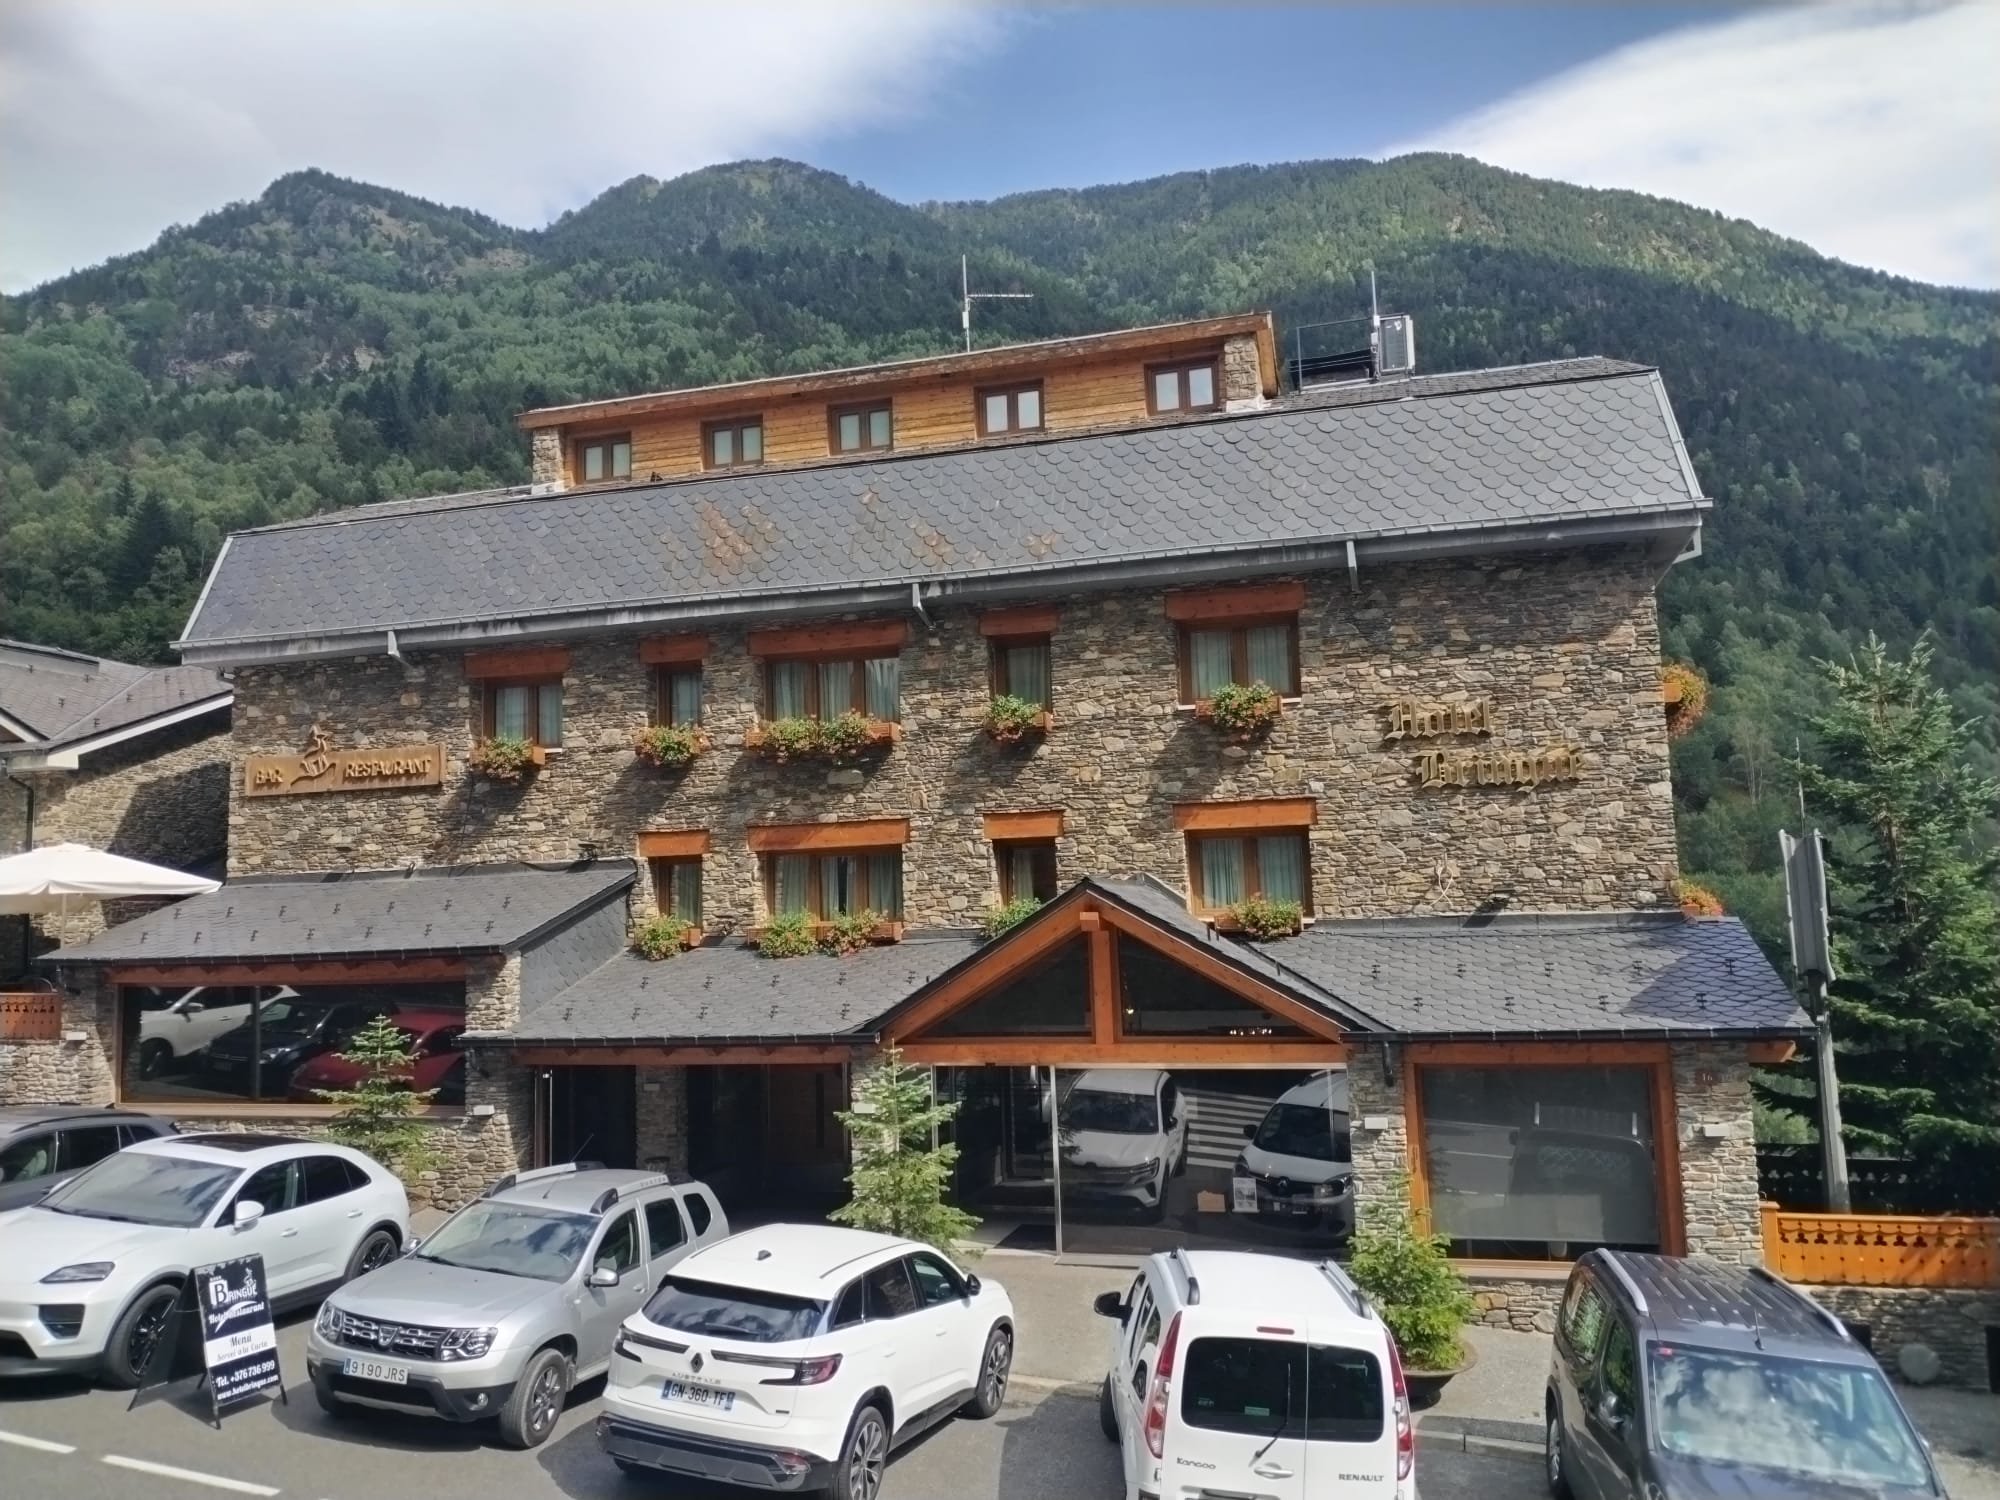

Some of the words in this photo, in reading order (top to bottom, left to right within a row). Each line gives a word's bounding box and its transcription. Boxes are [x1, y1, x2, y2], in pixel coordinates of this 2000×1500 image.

[1384, 696, 1491, 740] Hotel
[255, 767, 283, 785] BAR
[344, 757, 433, 778] RESTAURANT
[215, 1375, 230, 1388] Tel.
[261, 1359, 275, 1373] 999
[351, 1361, 382, 1378] 9190
[383, 1367, 406, 1382] JRS
[1176, 1457, 1217, 1470] Kangoo
[1338, 1473, 1384, 1482] RENAULT
